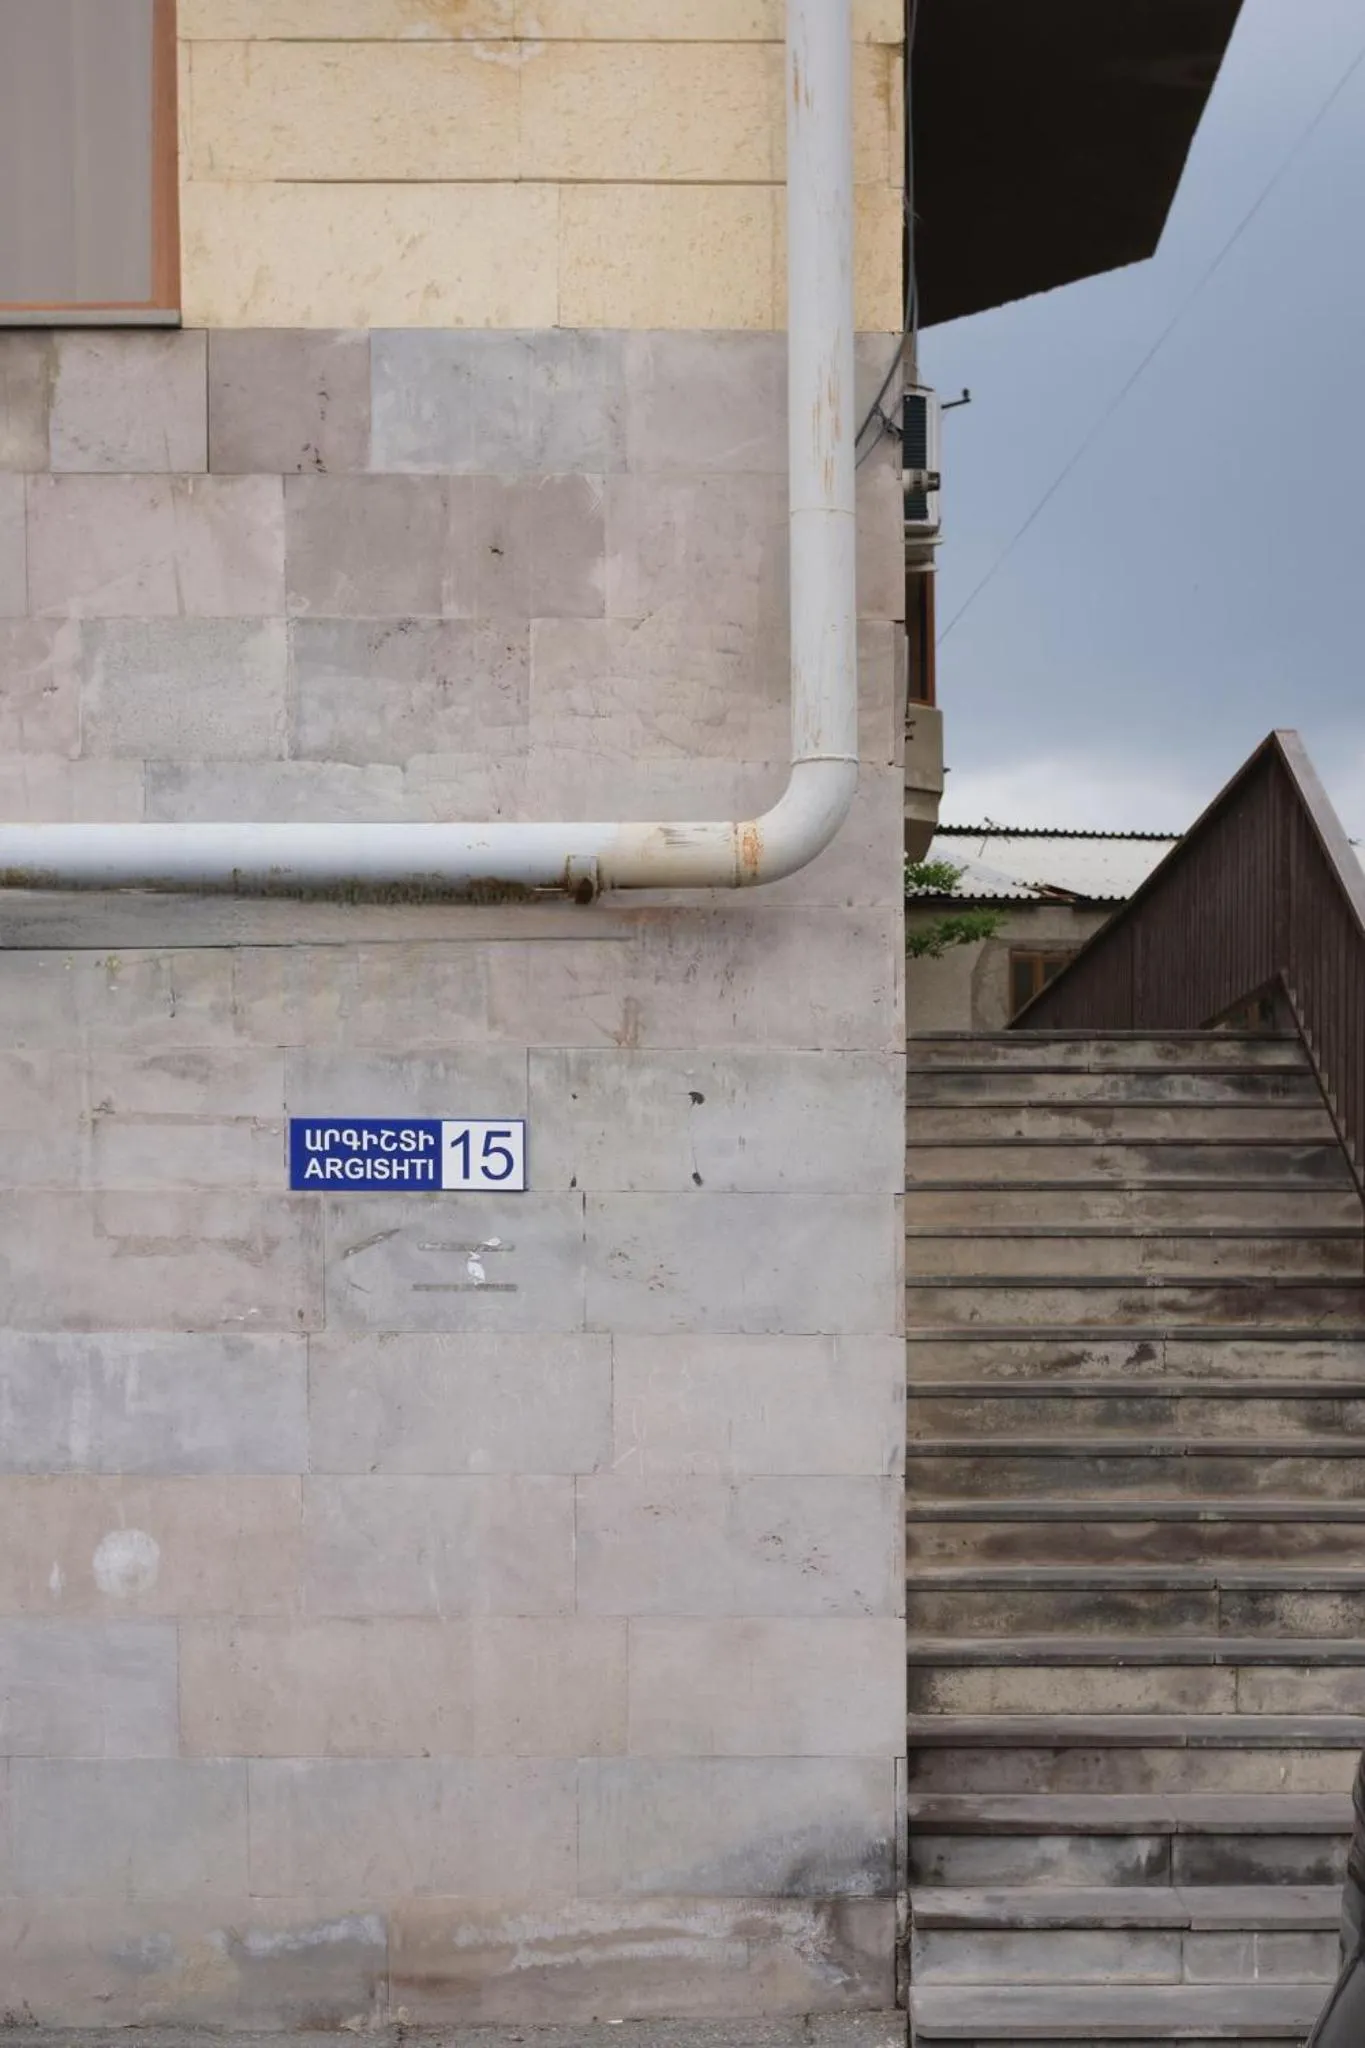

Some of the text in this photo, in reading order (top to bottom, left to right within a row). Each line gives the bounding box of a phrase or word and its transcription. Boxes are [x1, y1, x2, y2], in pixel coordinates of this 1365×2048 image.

[304, 1128, 435, 1152] ԱՐԳԻՇՏԻ
[450, 1129, 514, 1181] 15
[304, 1157, 434, 1180] ARGISHTI
